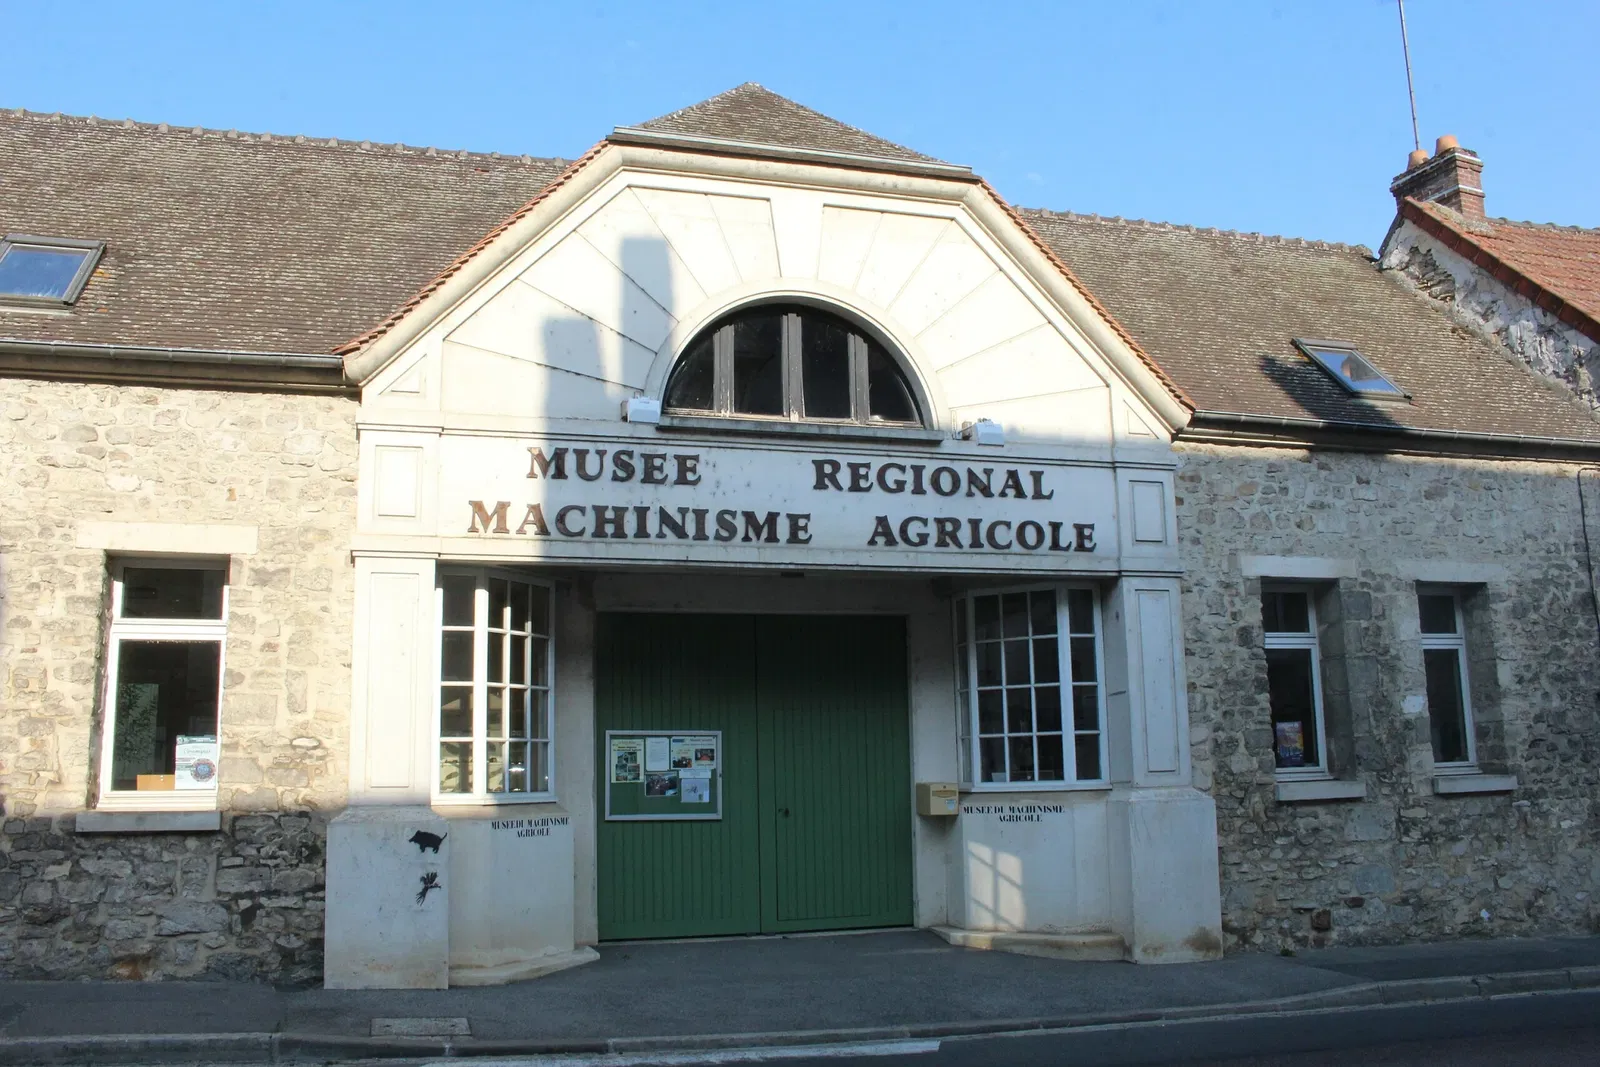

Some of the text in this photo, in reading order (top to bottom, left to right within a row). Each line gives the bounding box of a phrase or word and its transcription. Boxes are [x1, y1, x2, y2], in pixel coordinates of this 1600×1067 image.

[526, 447, 1054, 500] MUSEE REGIONAL
[468, 500, 1097, 552] MACHINISME AGRICOLE
[1008, 805, 1066, 813] MACHINISME
[999, 814, 1043, 822] AGRICOLE
[517, 827, 551, 838] AGRICOLE
